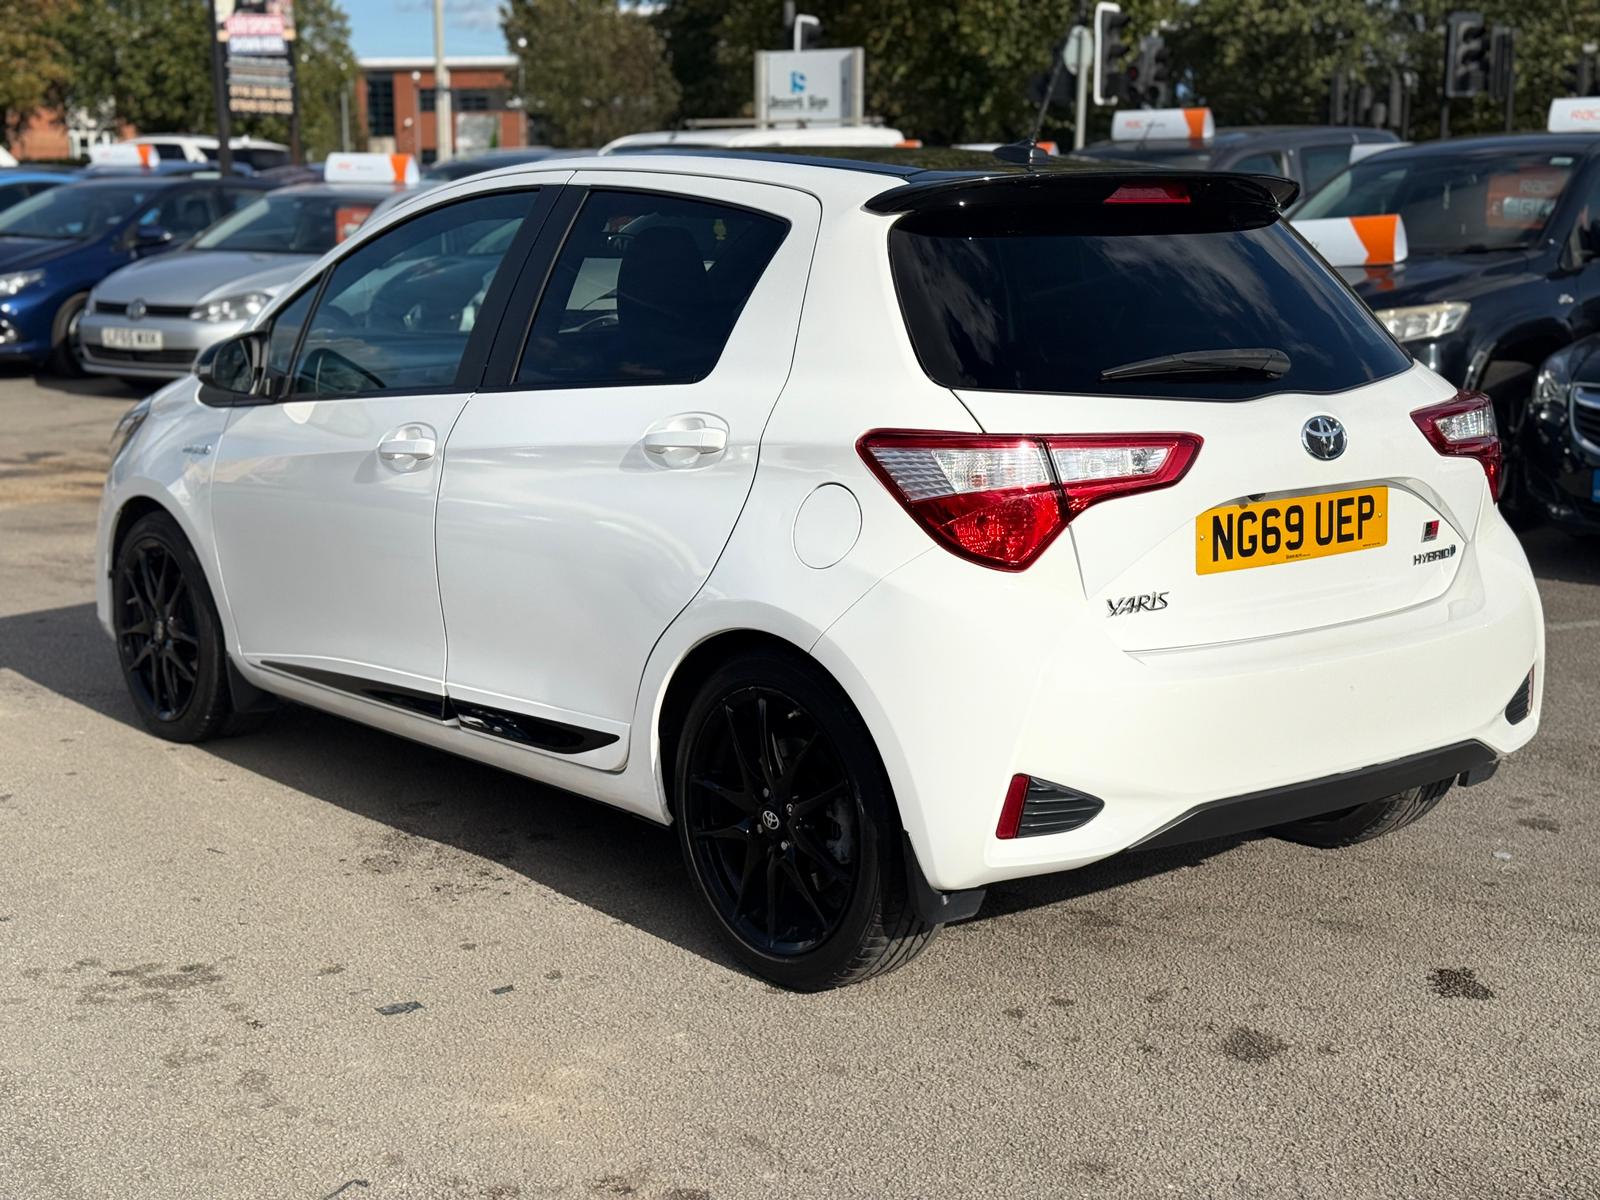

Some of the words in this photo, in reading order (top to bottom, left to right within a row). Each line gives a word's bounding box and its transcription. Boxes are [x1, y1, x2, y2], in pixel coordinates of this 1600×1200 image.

[1212, 504, 1304, 562] NG69
[1315, 494, 1375, 547] UEP
[1413, 547, 1450, 566] HYBRID
[1106, 591, 1170, 618] YARIS
